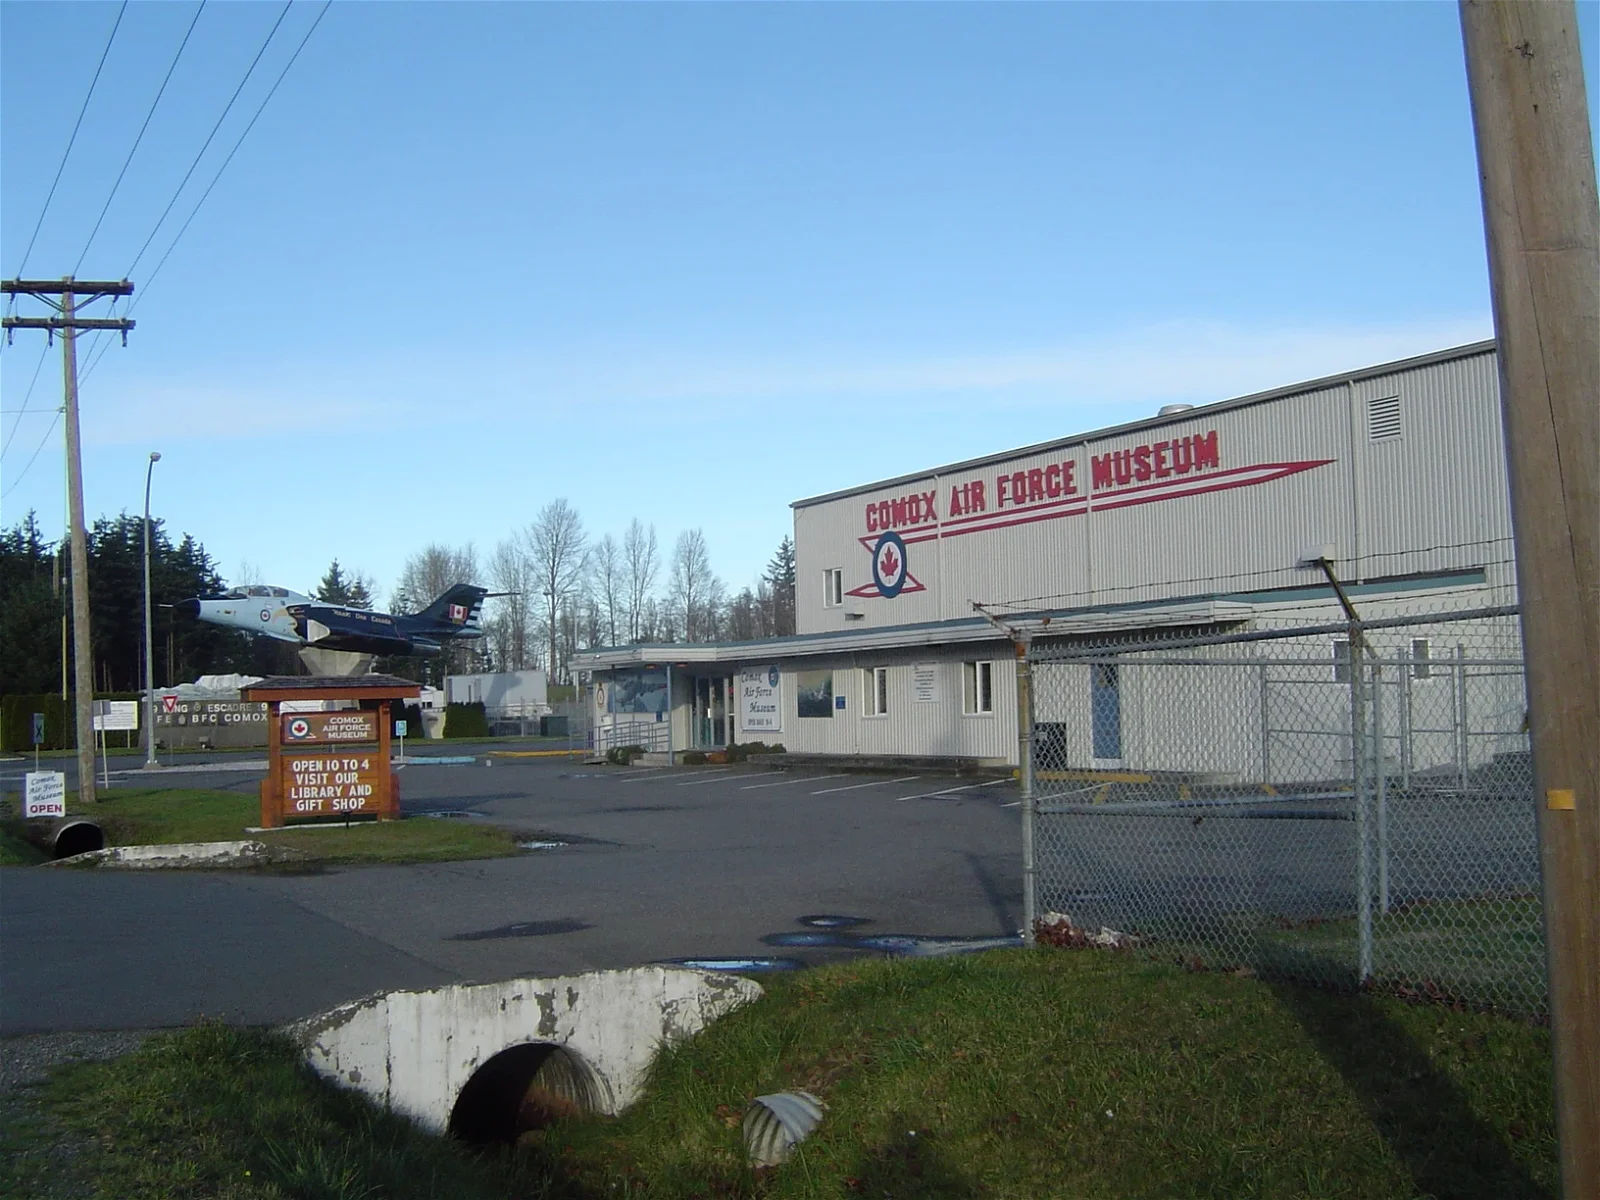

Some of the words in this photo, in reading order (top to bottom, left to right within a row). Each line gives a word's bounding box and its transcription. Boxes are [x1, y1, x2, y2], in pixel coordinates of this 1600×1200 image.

[865, 490, 938, 532] COMOX
[949, 480, 985, 517] AIR
[997, 460, 1077, 507] FORCE
[1091, 430, 1219, 490] MUSEUM
[163, 704, 188, 713] WNG
[207, 703, 252, 712] ESCADRE
[192, 714, 217, 723] BFC
[224, 713, 268, 722] COMOX
[330, 716, 364, 724] COMOX
[322, 724, 338, 732] AIR
[340, 723, 371, 731] FORCE
[328, 731, 368, 739] MUSEUM
[292, 760, 323, 772] OPEN
[342, 759, 358, 771] TO
[361, 759, 369, 770] 4
[296, 773, 328, 785] VISIT
[335, 772, 359, 784] OUR
[291, 785, 343, 799] LIBRARY
[349, 784, 372, 797] AND
[30, 804, 62, 814] OPEN
[296, 799, 324, 811] GIFT
[332, 798, 366, 810] SHOP
